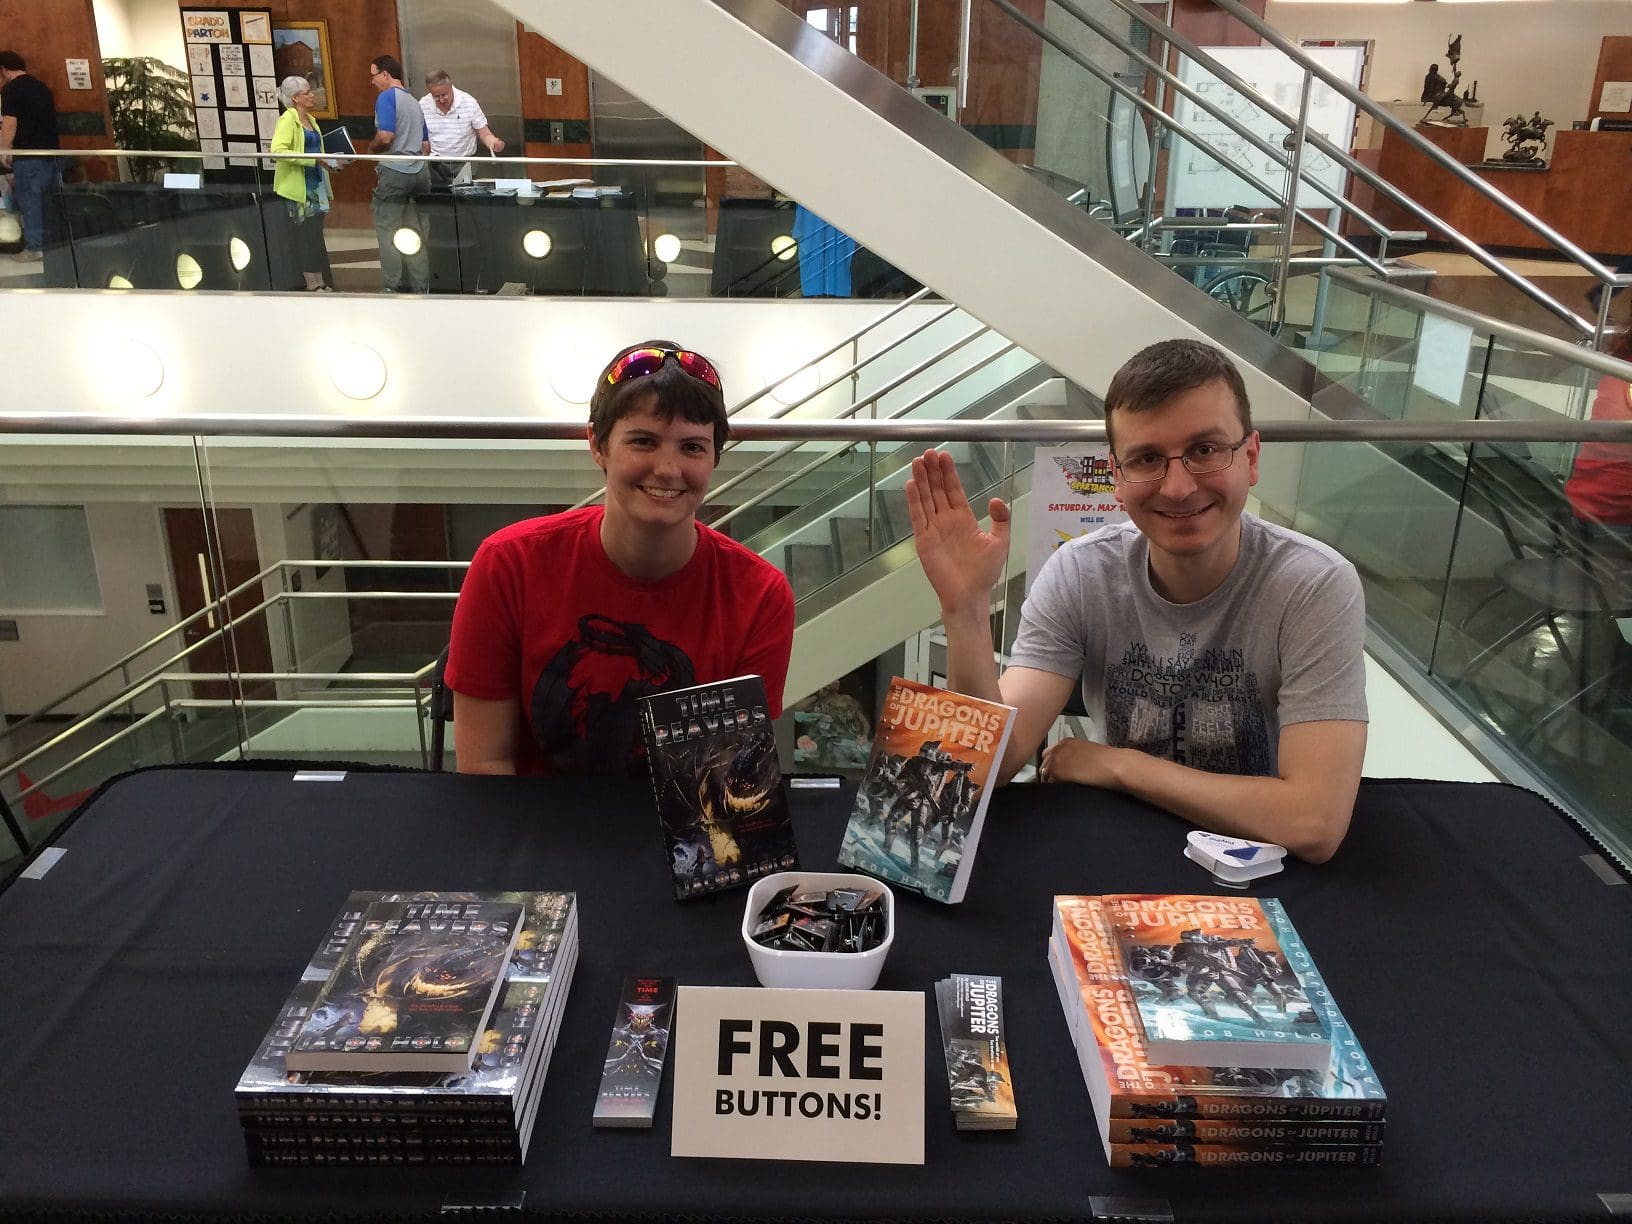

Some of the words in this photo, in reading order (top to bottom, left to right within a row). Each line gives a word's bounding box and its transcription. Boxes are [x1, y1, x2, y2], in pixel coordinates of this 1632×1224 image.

[1097, 503, 1117, 512] MAY
[676, 688, 736, 717] TIME
[900, 687, 1001, 731] DRAGONS
[891, 705, 995, 754] JUPITER
[406, 903, 482, 919] TIME
[1121, 900, 1254, 915] DRAGONS
[1267, 901, 1292, 933] HOLO
[1126, 911, 1262, 930] JUPITER
[969, 981, 986, 1033] JUPITER
[986, 983, 1000, 1035] DRAGONS
[1316, 990, 1345, 1028] HOLO
[391, 1036, 465, 1049] HOLO
[1096, 988, 1140, 1081] DRAGONS
[1255, 1030, 1322, 1040] HOLO
[717, 1018, 884, 1081] FREE
[1344, 1039, 1380, 1096] JACOB
[1119, 1081, 1142, 1090] THE
[1140, 1071, 1155, 1090] OF
[715, 1089, 882, 1121] BUTTONS!
[1209, 1103, 1287, 1116] DRAGONS
[1301, 1103, 1362, 1117] JUPITER
[1206, 1127, 1286, 1139] DRAGONS
[1299, 1127, 1359, 1139] JUPITER
[1206, 1151, 1285, 1163] DRAGONS
[1296, 1151, 1357, 1163] JUPITER
